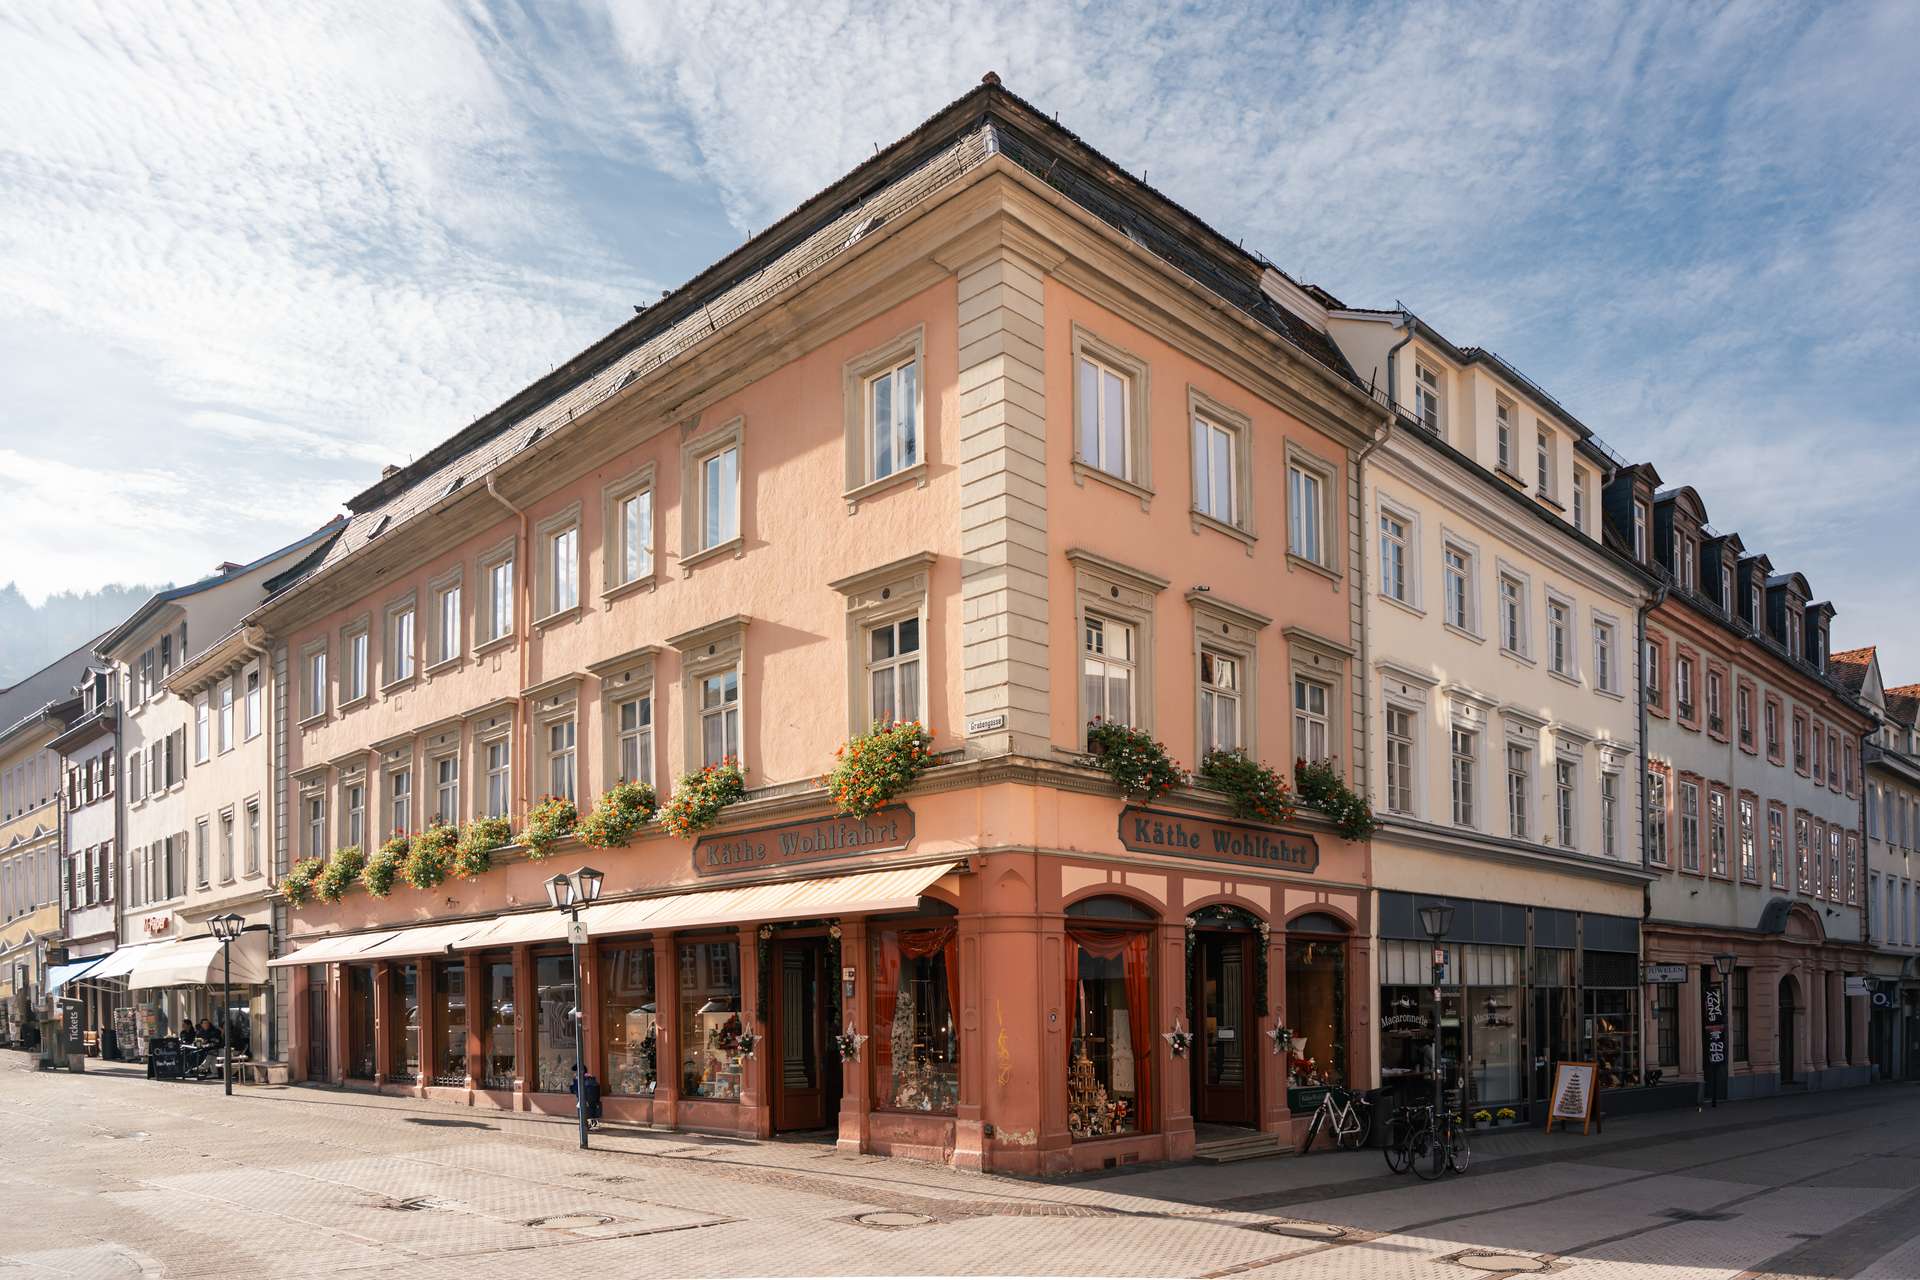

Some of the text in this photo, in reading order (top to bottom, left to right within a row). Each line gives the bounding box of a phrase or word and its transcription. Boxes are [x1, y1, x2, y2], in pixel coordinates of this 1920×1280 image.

[970, 718, 1002, 731] Grabengasse
[705, 820, 898, 867] Käthe Wohlfahrt
[1135, 817, 1307, 865] Käthe Wohlfahrt
[69, 1011, 79, 1042] Tickets
